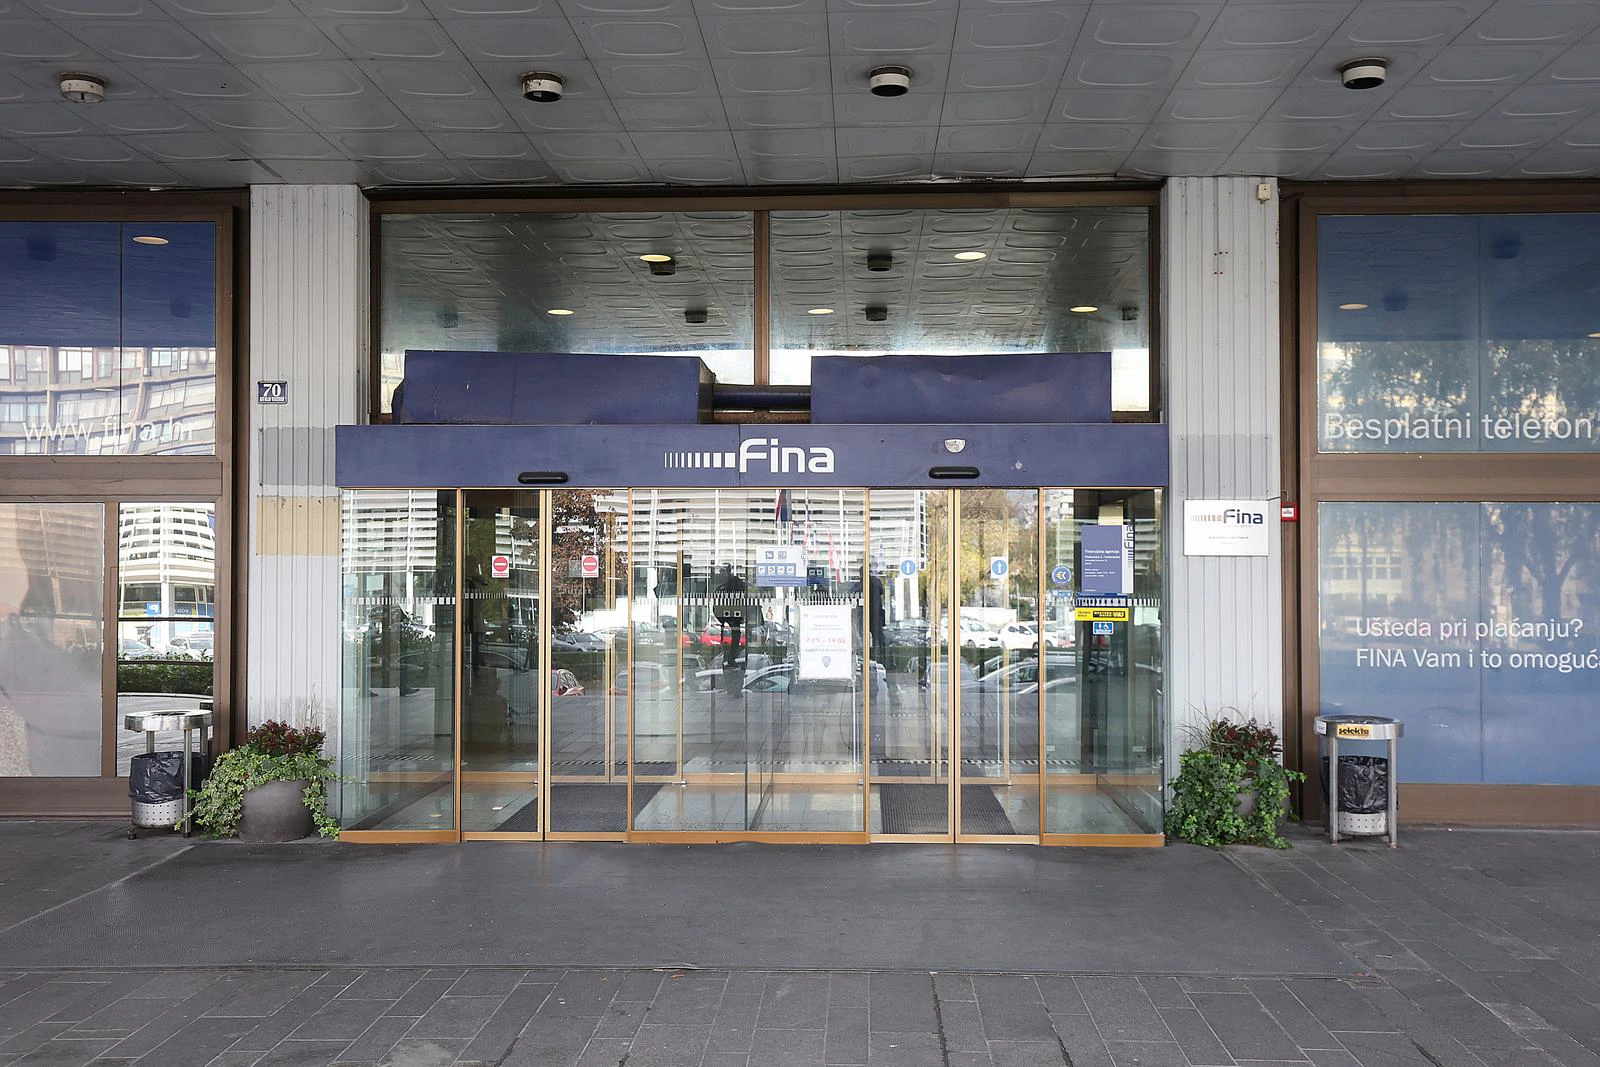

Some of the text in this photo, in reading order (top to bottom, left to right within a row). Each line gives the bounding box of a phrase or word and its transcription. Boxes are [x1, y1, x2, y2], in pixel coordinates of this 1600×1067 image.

[263, 383, 282, 397] 70
[22, 416, 199, 442] www.fina.hr
[1324, 412, 1592, 444] Besplatni telefon
[739, 438, 835, 473] Fina
[1223, 508, 1264, 525] Fina
[1356, 617, 1584, 642] Ušteda pri plaćanju?
[1356, 648, 1600, 673] FINA Vam i to omoguć
[1338, 726, 1370, 736] selekta
